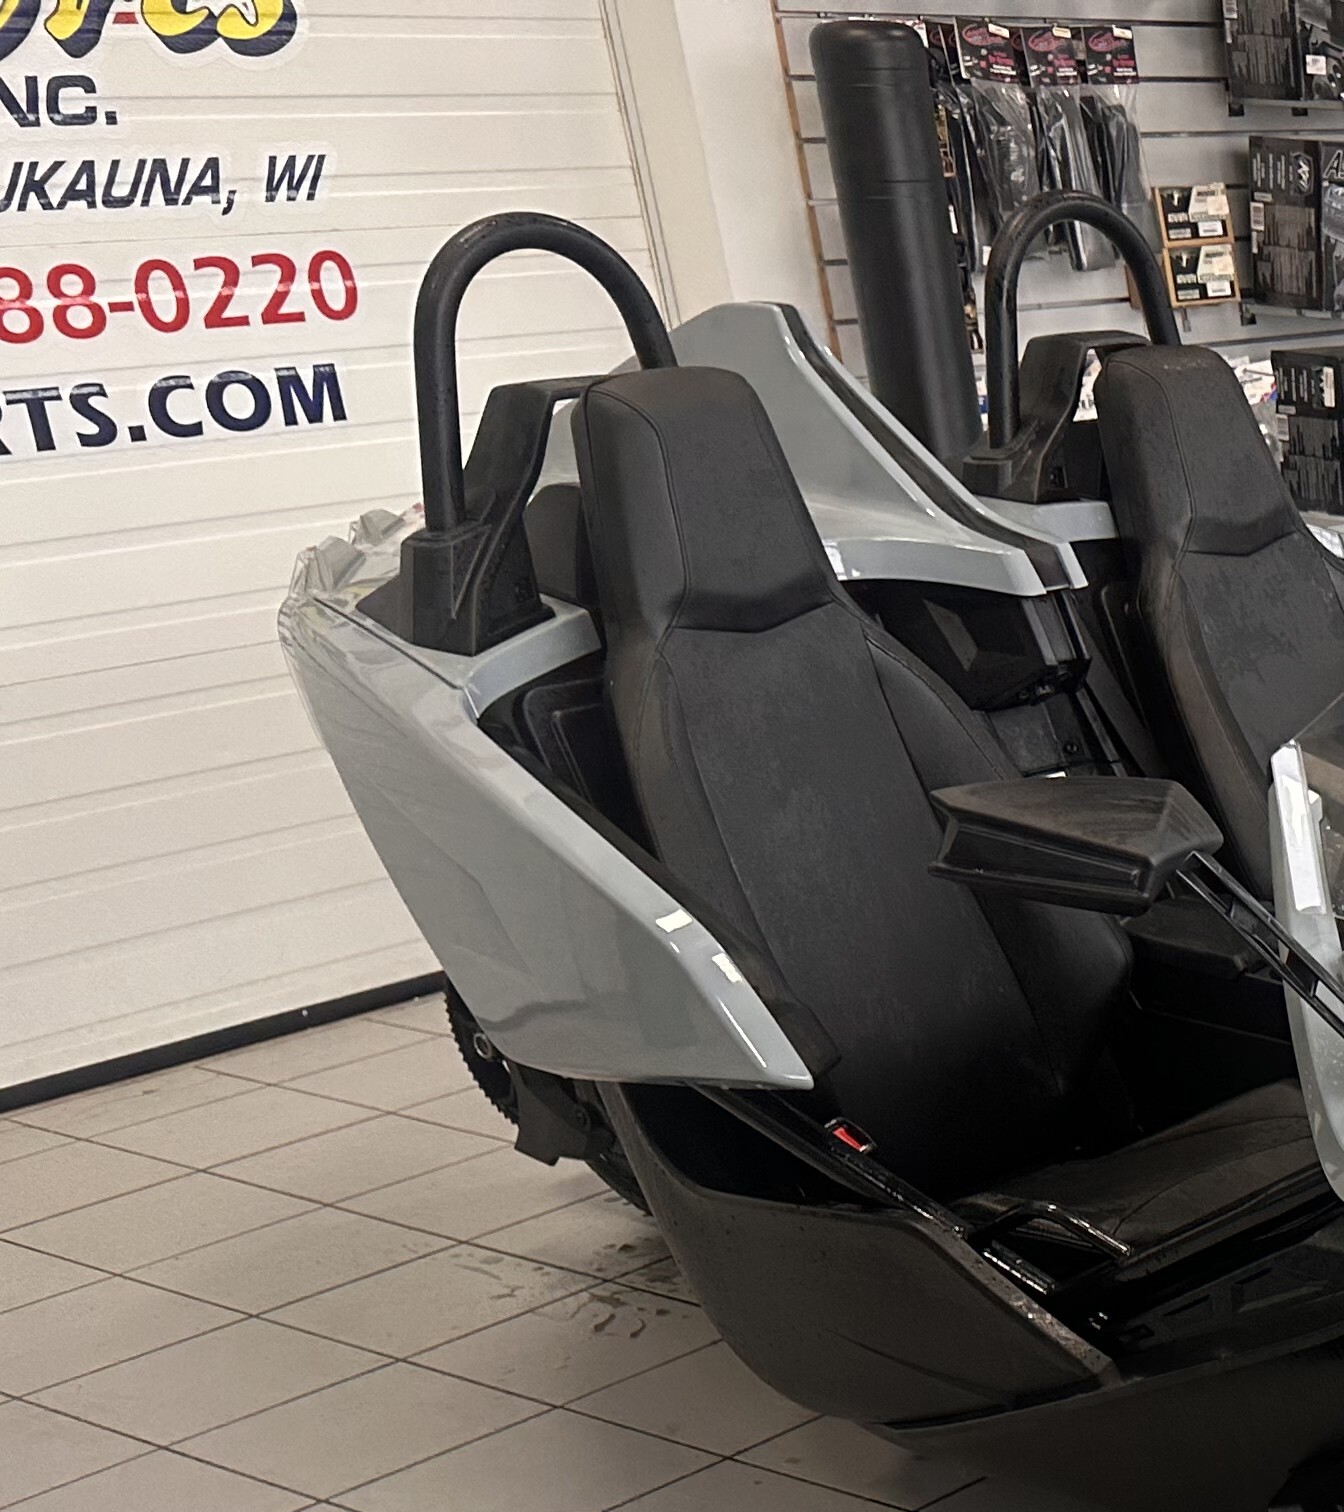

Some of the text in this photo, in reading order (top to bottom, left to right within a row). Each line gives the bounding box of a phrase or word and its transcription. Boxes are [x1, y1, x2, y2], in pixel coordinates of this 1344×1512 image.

[265, 154, 326, 203] WI
[0, 250, 358, 343] 88-0220
[0, 363, 347, 454] TS.COM
